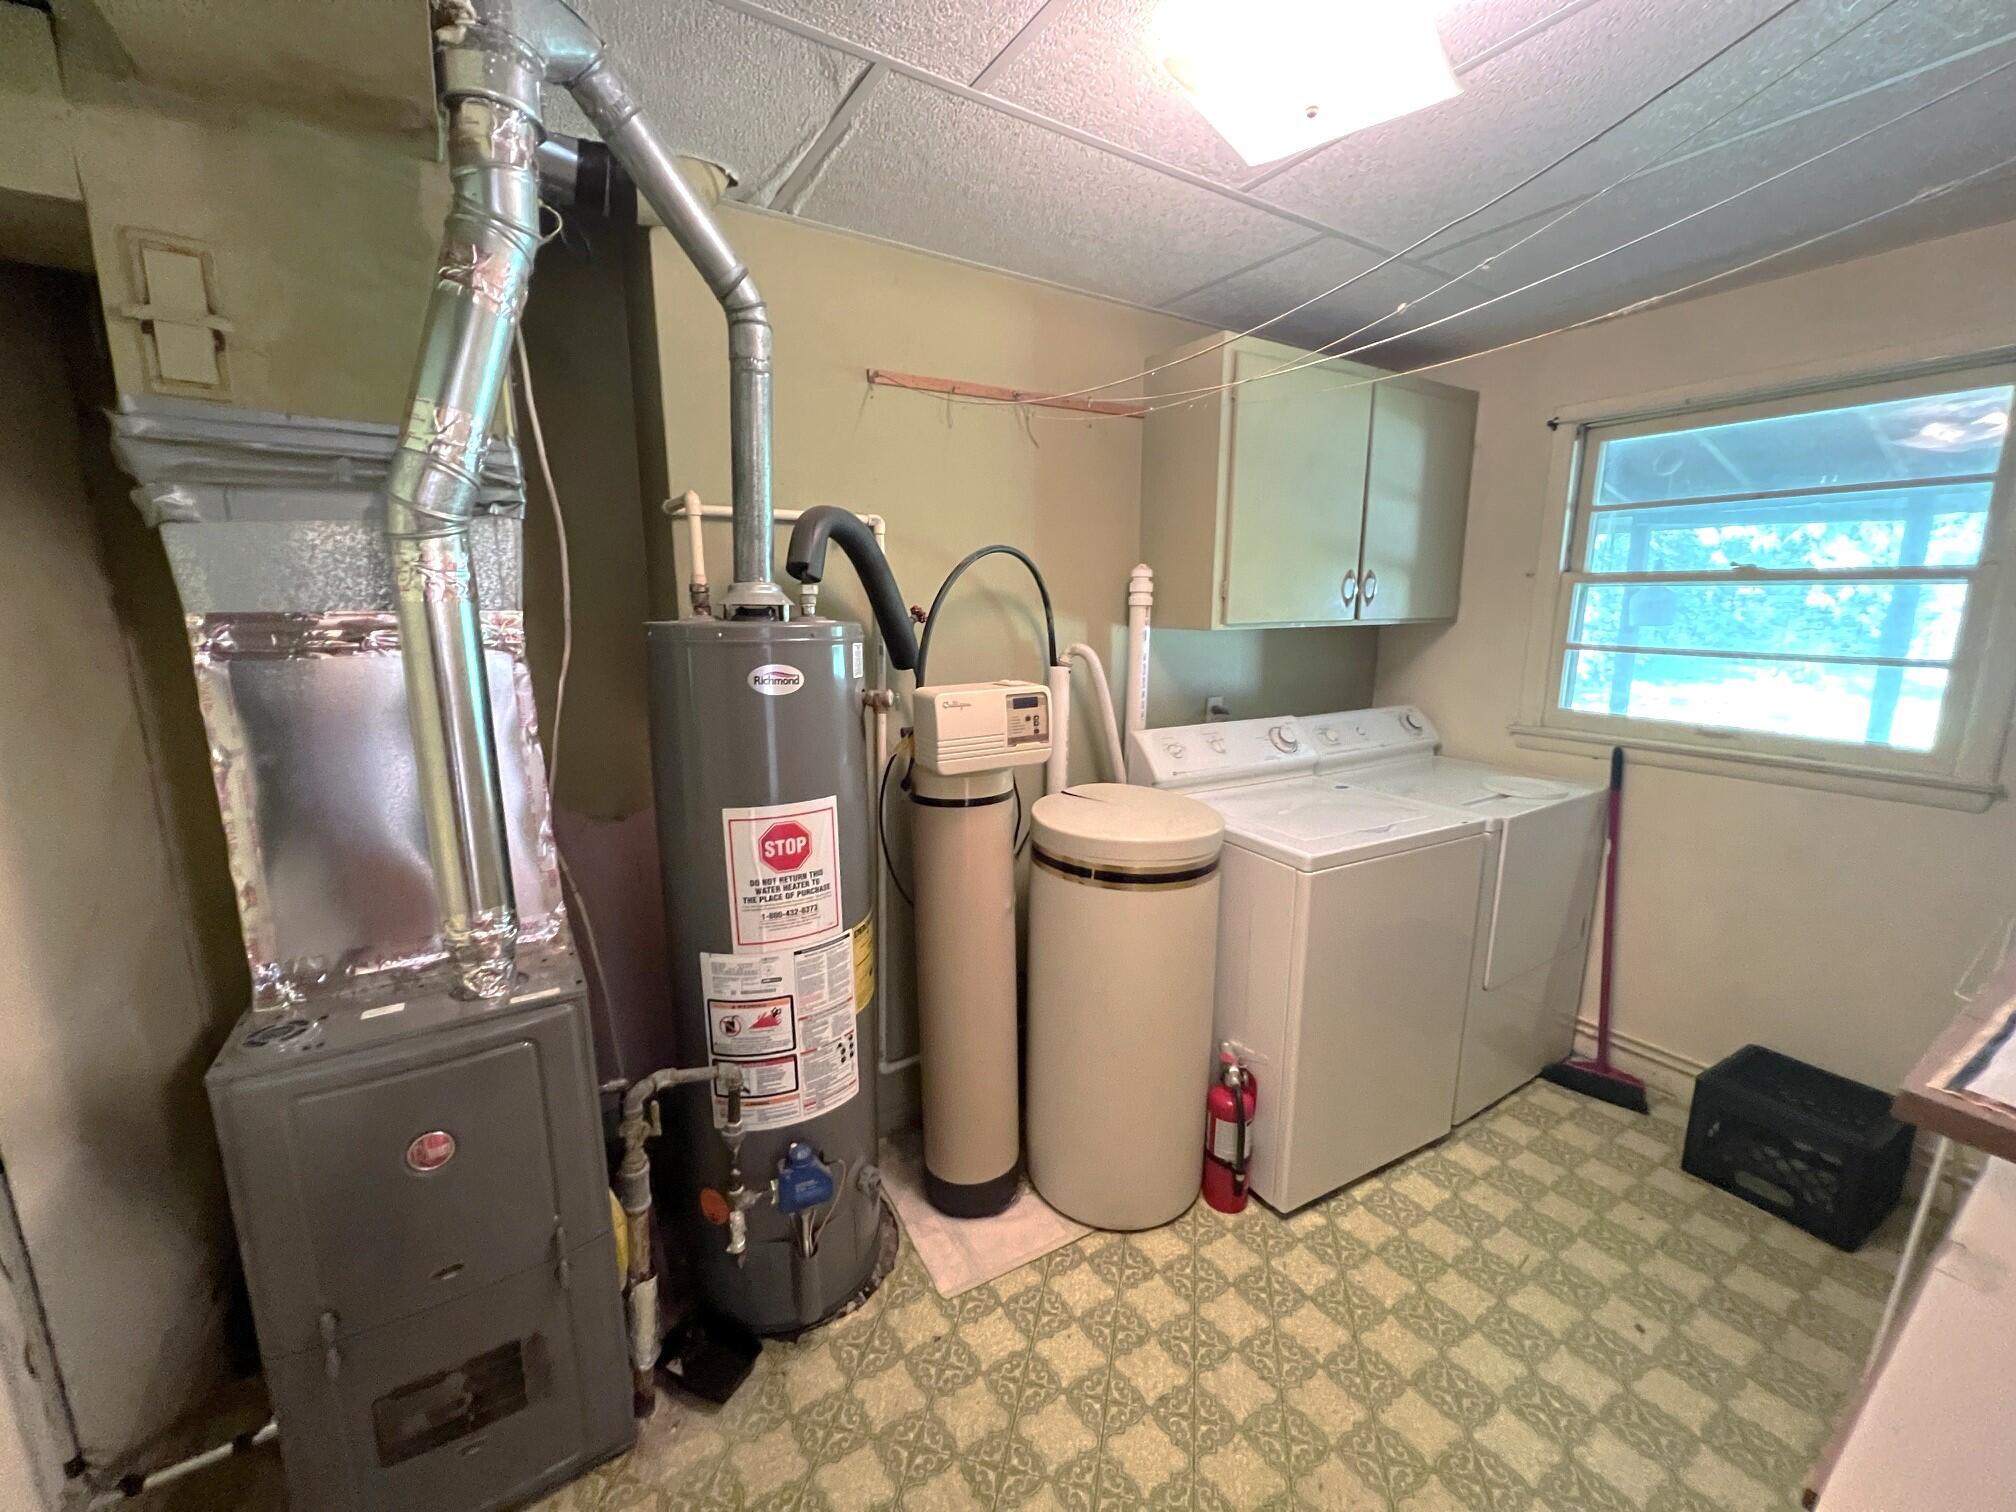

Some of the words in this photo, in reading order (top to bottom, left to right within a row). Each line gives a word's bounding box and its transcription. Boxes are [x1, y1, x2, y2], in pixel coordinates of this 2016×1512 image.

[754, 675, 800, 686] Richmond
[764, 836, 807, 857] STOP
[750, 879, 760, 887] DO
[779, 873, 807, 883] RETURN
[809, 869, 824, 878] THIS
[755, 886, 781, 895] WATER
[783, 881, 810, 891] HEATER
[760, 895, 783, 903] PLACE
[796, 883, 830, 897] PURCHASE
